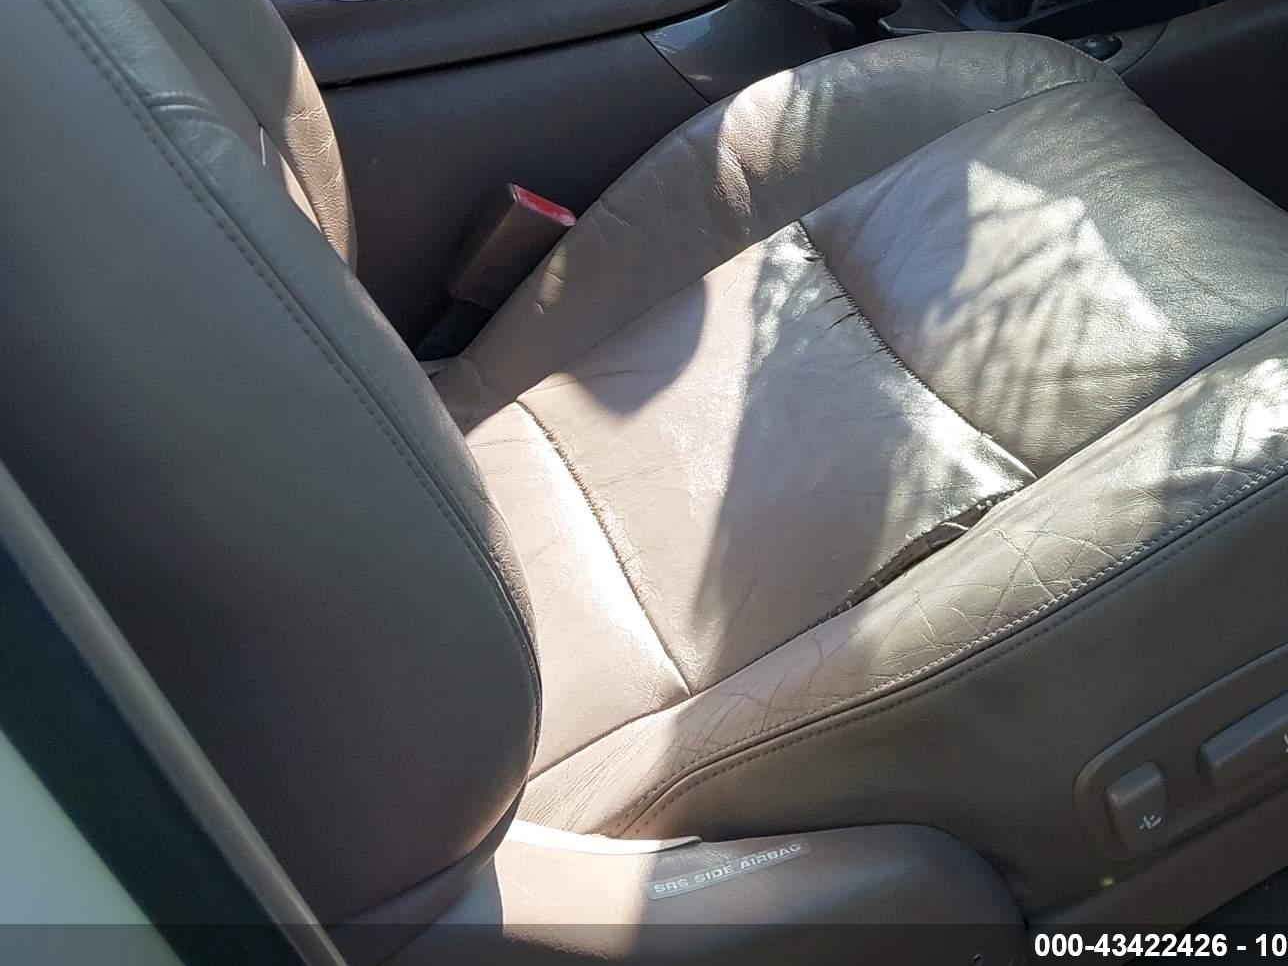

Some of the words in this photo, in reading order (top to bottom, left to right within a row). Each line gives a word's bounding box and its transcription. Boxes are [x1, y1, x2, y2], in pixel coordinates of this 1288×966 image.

[654, 878, 689, 893] SRS
[694, 864, 734, 883] SIDE
[739, 843, 802, 870] AIRBAG
